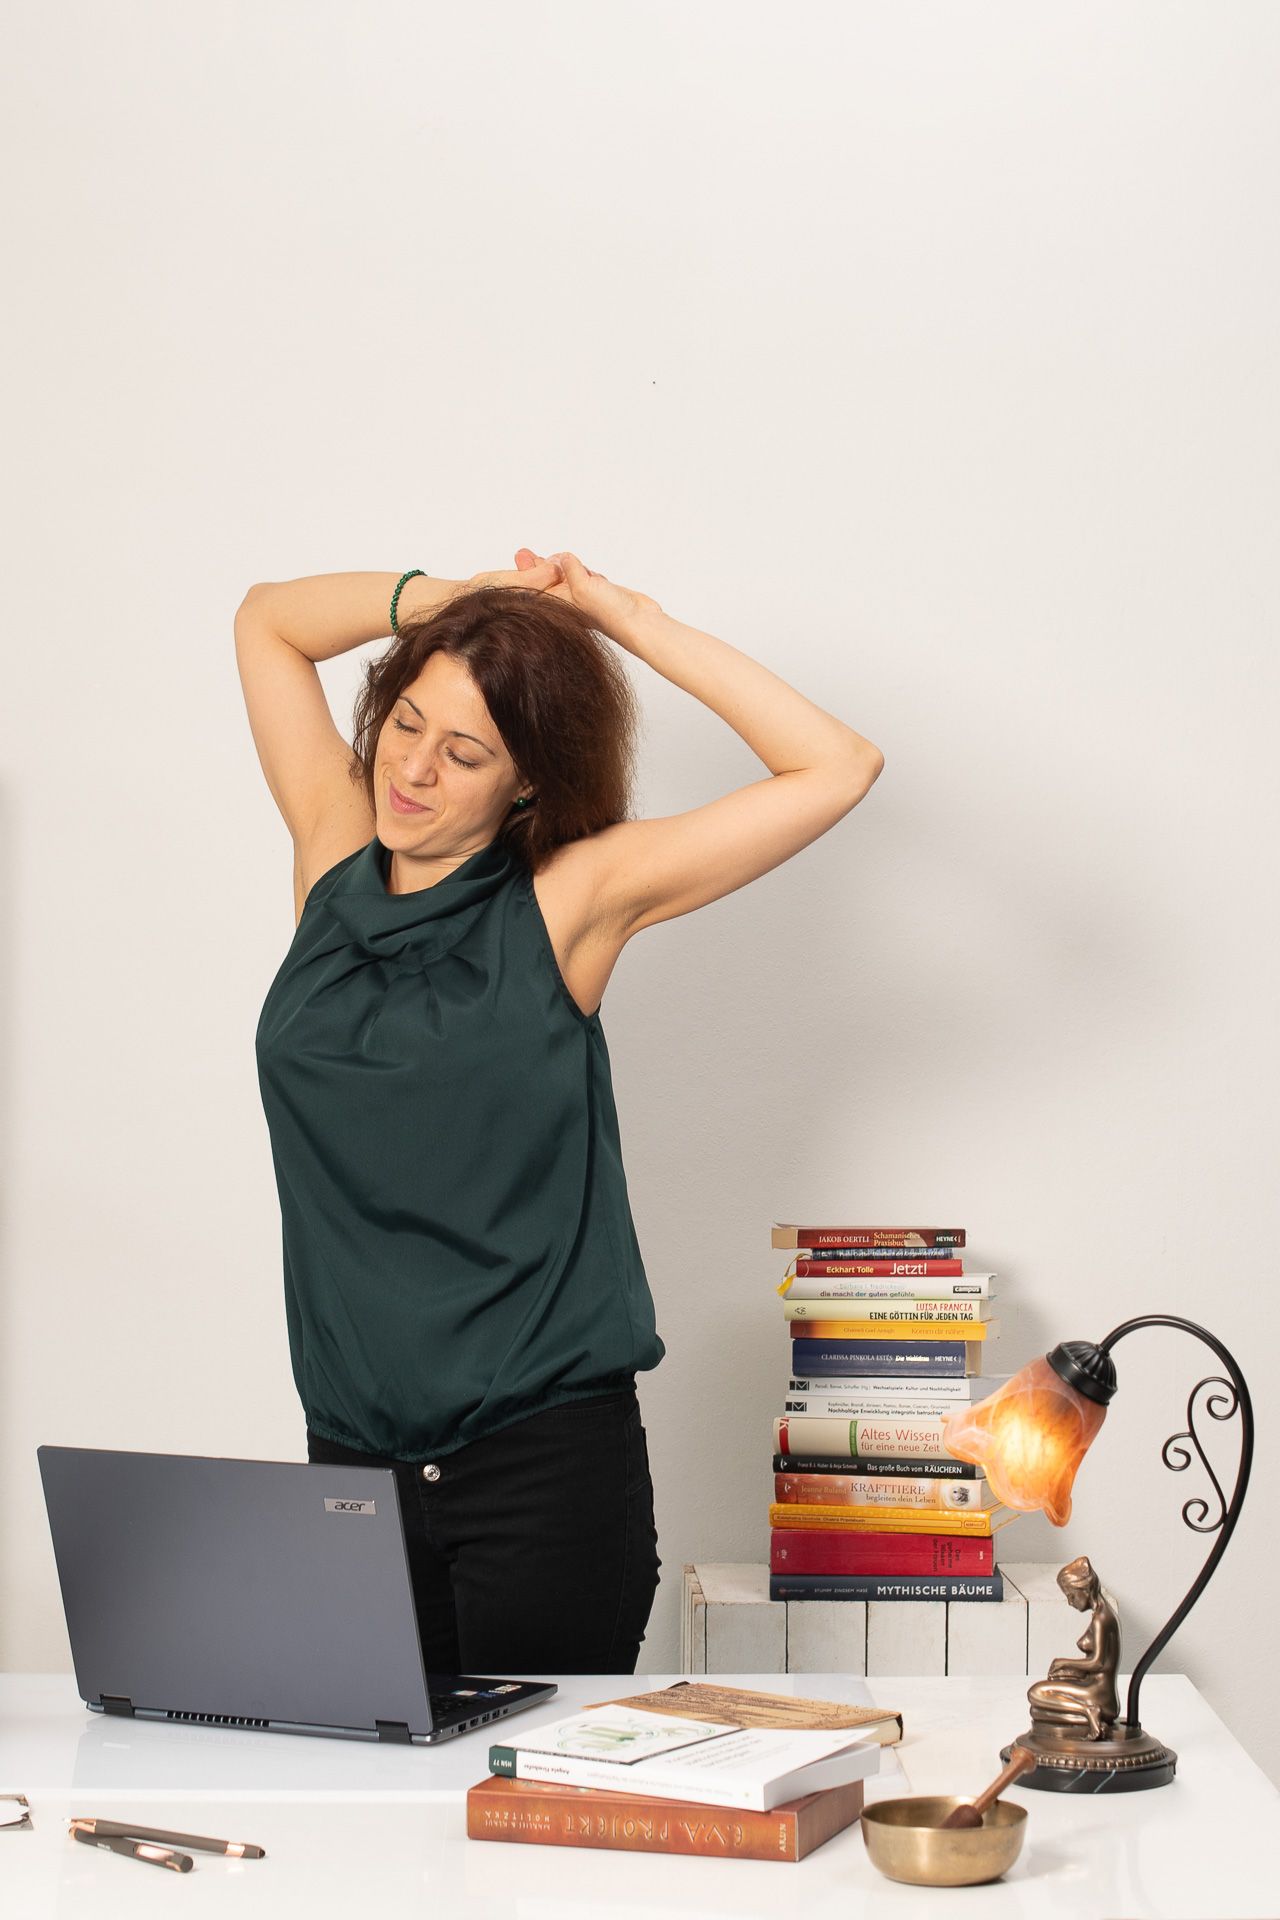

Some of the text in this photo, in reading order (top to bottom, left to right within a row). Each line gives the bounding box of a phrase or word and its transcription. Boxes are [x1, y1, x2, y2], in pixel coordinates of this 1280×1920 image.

[826, 1266, 874, 1274] Eckhart Tolle
[890, 1262, 927, 1276] Jetzt!
[916, 1303, 973, 1312] LUISA FRANCIA
[870, 1311, 974, 1321] EINE GÖTTIN FÜR JEDEN TAG
[860, 1428, 940, 1442] Altes Wissen
[861, 1442, 940, 1452] für eine neue Zeit
[867, 1463, 877, 1472] Das
[878, 1464, 895, 1473] große
[896, 1464, 910, 1473] Buch
[924, 1464, 962, 1474] RÄUCHERN
[850, 1482, 926, 1495] KRAFTTIERE
[866, 1494, 896, 1504] begleiten
[914, 1495, 936, 1504] Leben
[334, 1501, 366, 1512] acer
[877, 1582, 993, 1595] MYTHISCHE BÄUME
[484, 1810, 550, 1822] HOLITZKA
[566, 1814, 669, 1841] PROJEKT
